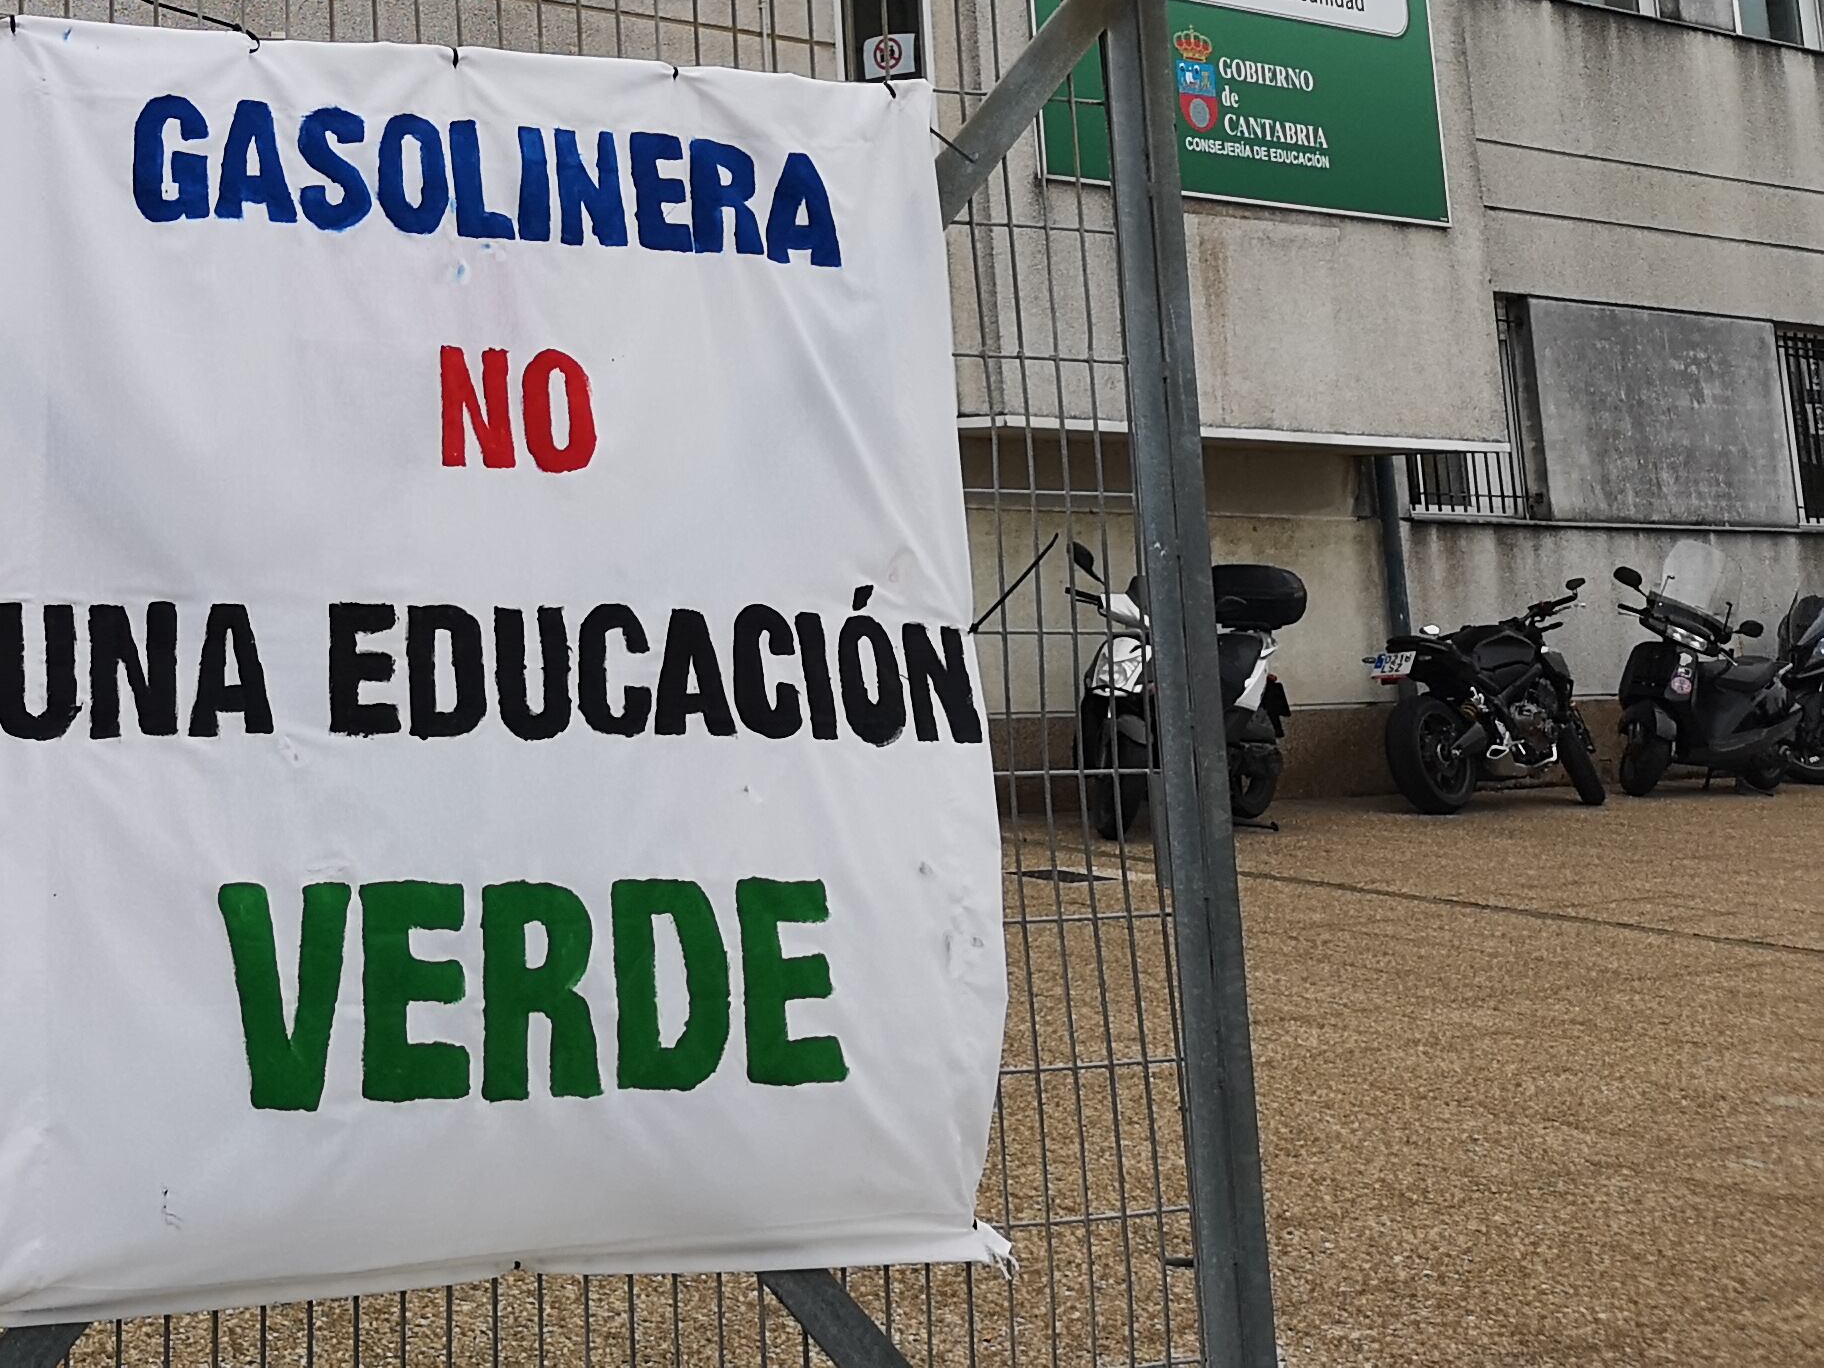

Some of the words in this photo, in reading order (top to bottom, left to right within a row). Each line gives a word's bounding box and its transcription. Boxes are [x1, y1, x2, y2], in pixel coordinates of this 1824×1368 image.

[1218, 56, 1314, 92] GOBIERNO
[1221, 85, 1239, 108] de
[1185, 136, 1253, 160] CONSEJERÍA
[1253, 145, 1269, 161] DE
[1270, 147, 1330, 169] EDUCACIÓN
[1223, 113, 1328, 149] CANTABRIA
[132, 93, 842, 269] GASOLINERA
[439, 344, 598, 473] NO
[328, 584, 984, 749] EDUCACIÓN
[217, 876, 850, 1113] VERDE
